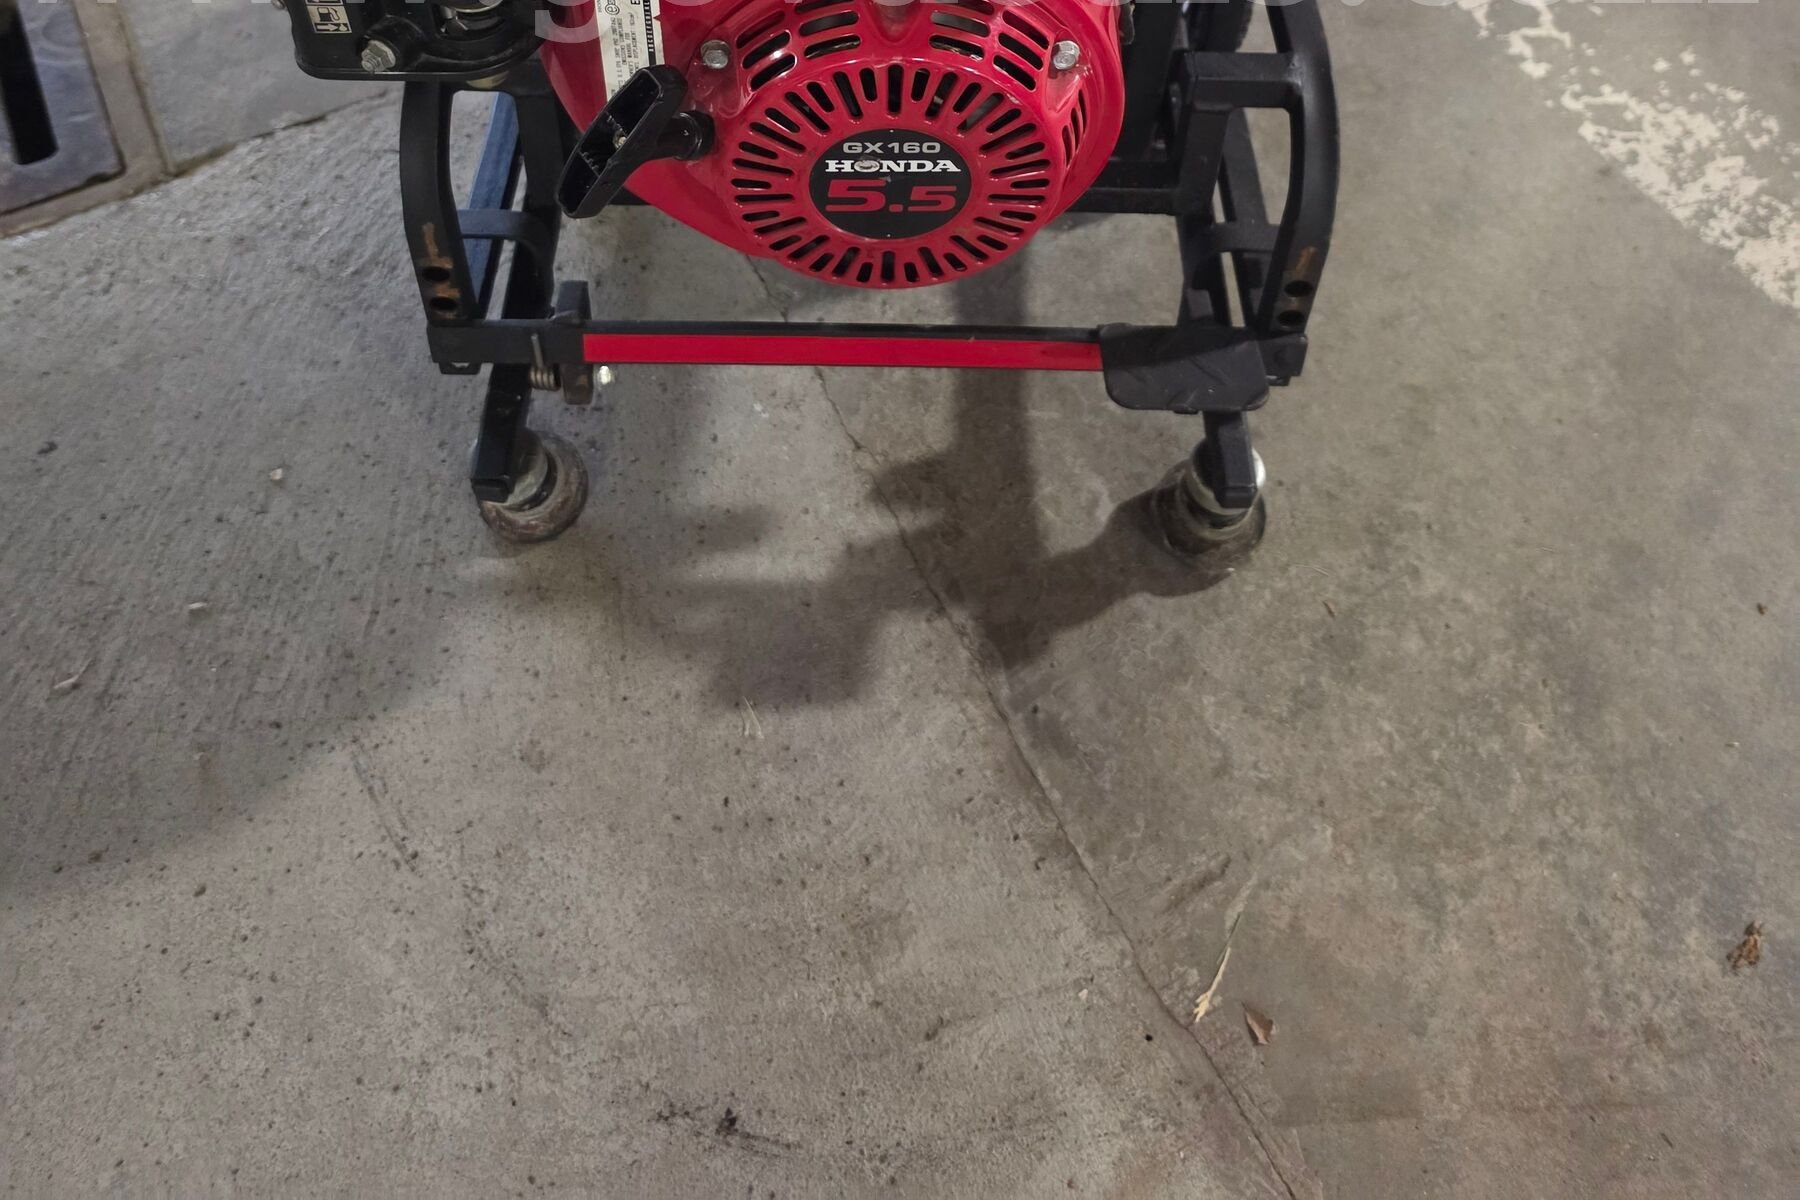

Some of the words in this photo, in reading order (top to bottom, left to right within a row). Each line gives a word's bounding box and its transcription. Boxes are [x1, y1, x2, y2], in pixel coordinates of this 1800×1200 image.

[842, 141, 941, 154] GX160
[824, 159, 961, 173] HONDA
[825, 178, 957, 213] 5.5
